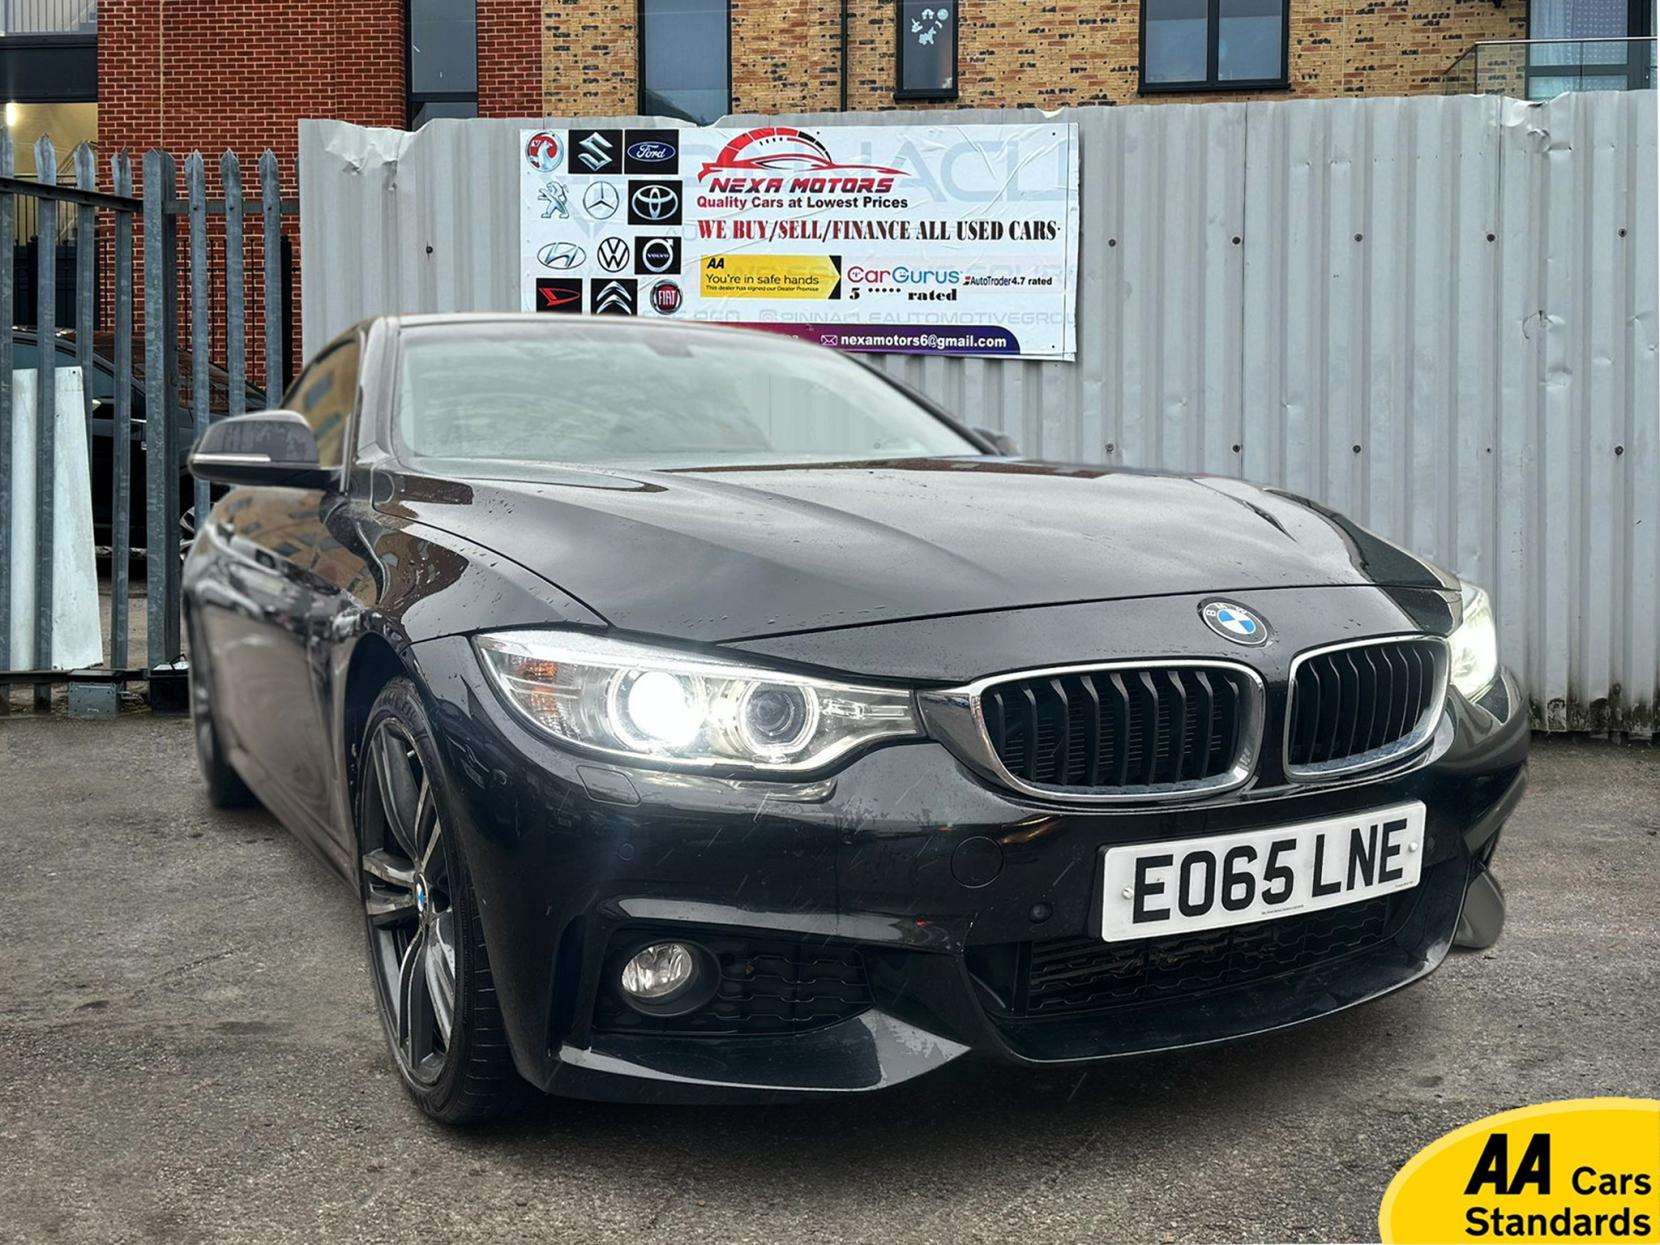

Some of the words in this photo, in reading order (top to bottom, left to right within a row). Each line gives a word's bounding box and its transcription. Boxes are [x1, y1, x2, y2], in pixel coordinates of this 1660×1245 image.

[636, 143, 666, 159] Ford
[708, 177, 784, 194] NEXA
[789, 177, 895, 194] MOTORS
[697, 196, 747, 210] Quality
[752, 196, 784, 208] Cars
[788, 197, 802, 208] at
[807, 196, 858, 208] Lowest
[863, 196, 908, 208] Prices
[697, 219, 726, 239] WE
[916, 220, 950, 240] ALL
[956, 220, 1003, 241] USED
[706, 257, 725, 269] AA
[705, 273, 741, 284] You're
[744, 274, 754, 284] in
[757, 273, 781, 285] safe
[784, 274, 820, 285] hands
[847, 266, 960, 284] CarGurus
[1028, 277, 1053, 286] rated
[658, 290, 676, 306] FIAT
[849, 287, 860, 300] 5
[908, 288, 957, 301] rated
[841, 334, 1007, 349] nexamotors6@gmail.com
[1311, 818, 1408, 898] LNE
